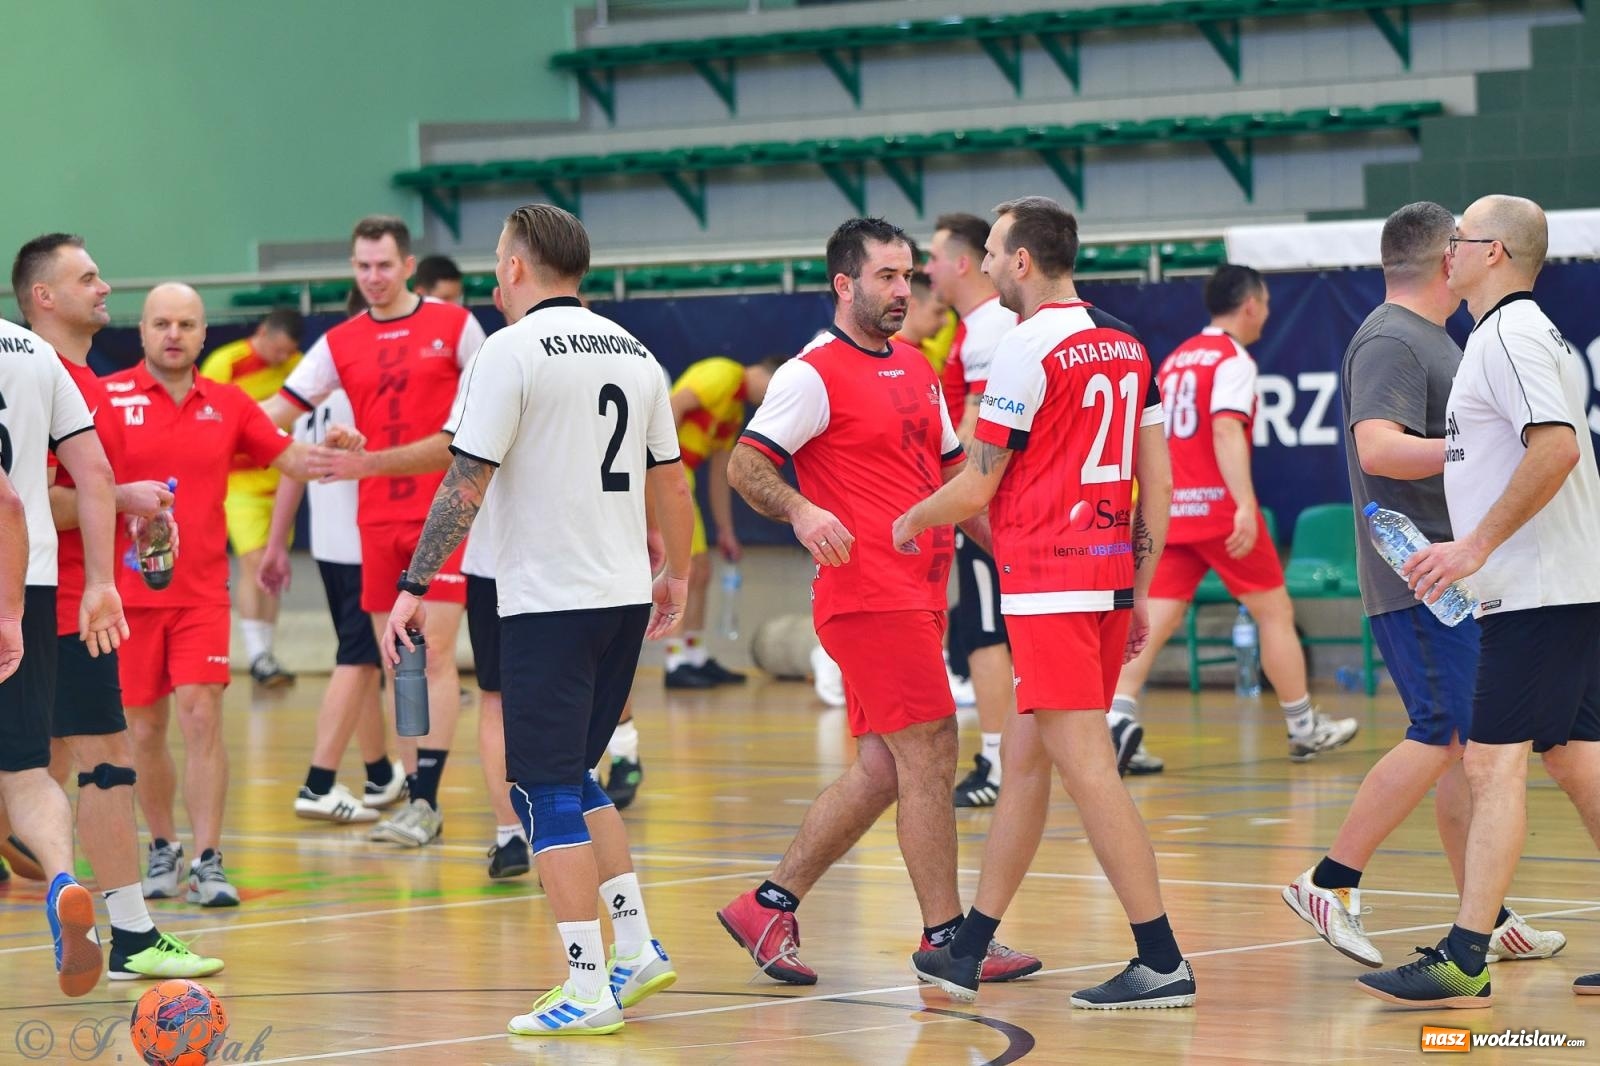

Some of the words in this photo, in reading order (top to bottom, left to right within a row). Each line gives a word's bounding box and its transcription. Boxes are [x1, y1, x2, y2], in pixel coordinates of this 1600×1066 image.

[539, 335, 568, 357] KS
[567, 334, 648, 359] KORNOWAC
[877, 369, 905, 378] regio
[598, 383, 630, 493] 2
[1080, 371, 1139, 485] 21
